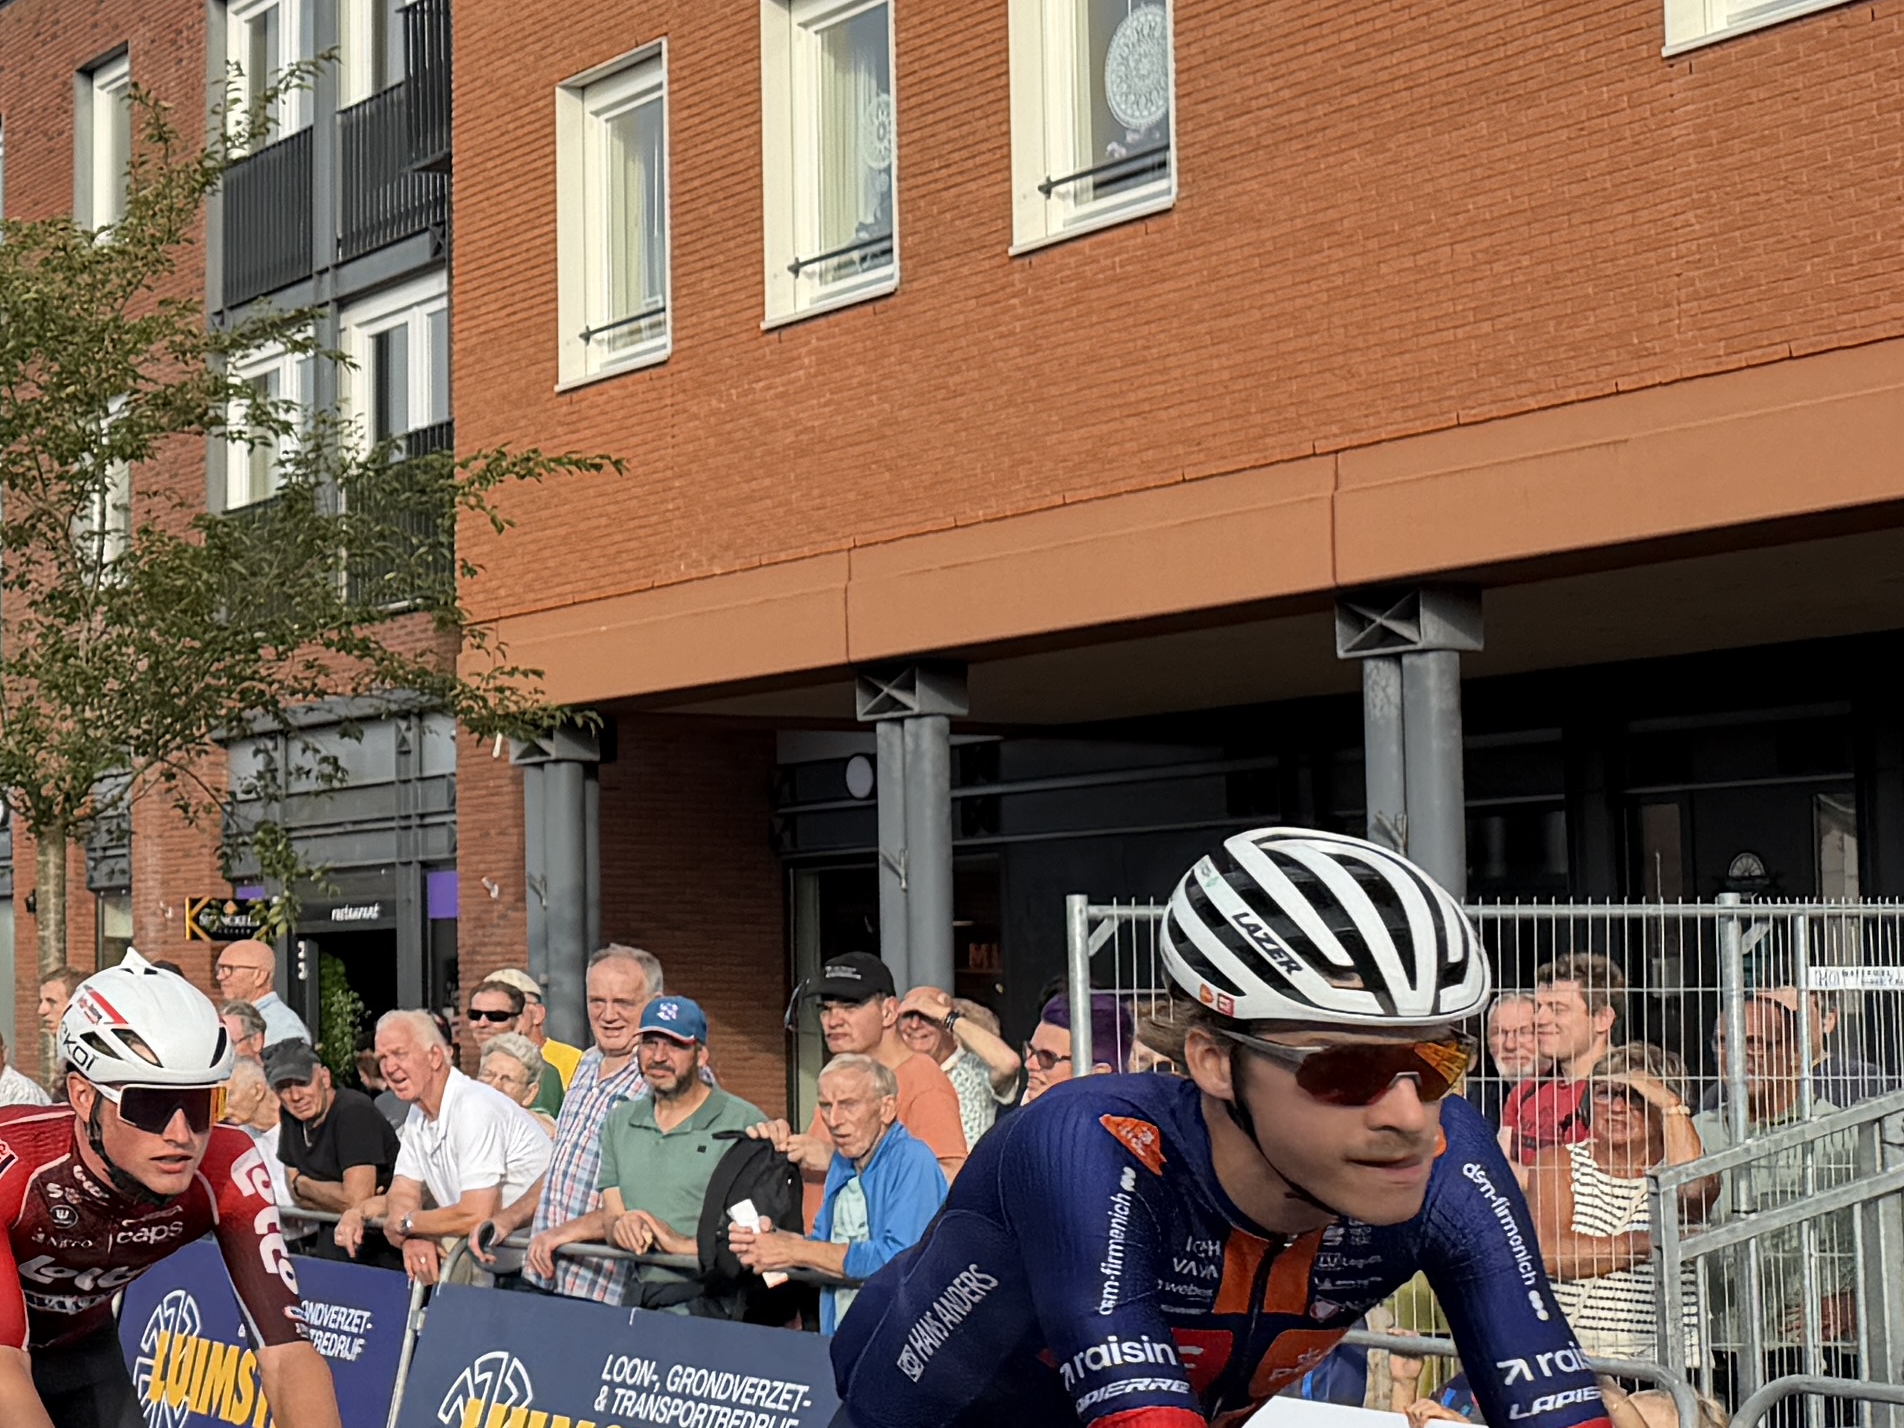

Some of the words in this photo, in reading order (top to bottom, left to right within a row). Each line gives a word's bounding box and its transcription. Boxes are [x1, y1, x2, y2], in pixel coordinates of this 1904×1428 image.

[1232, 912, 1303, 976] LAZER
[116, 1221, 184, 1245] caps
[908, 1312, 948, 1363] HANS
[933, 1264, 998, 1328] ANDERS
[1074, 1335, 1178, 1381] raisin
[594, 1385, 608, 1413] &
[666, 1364, 812, 1414] GRONDVERZET-
